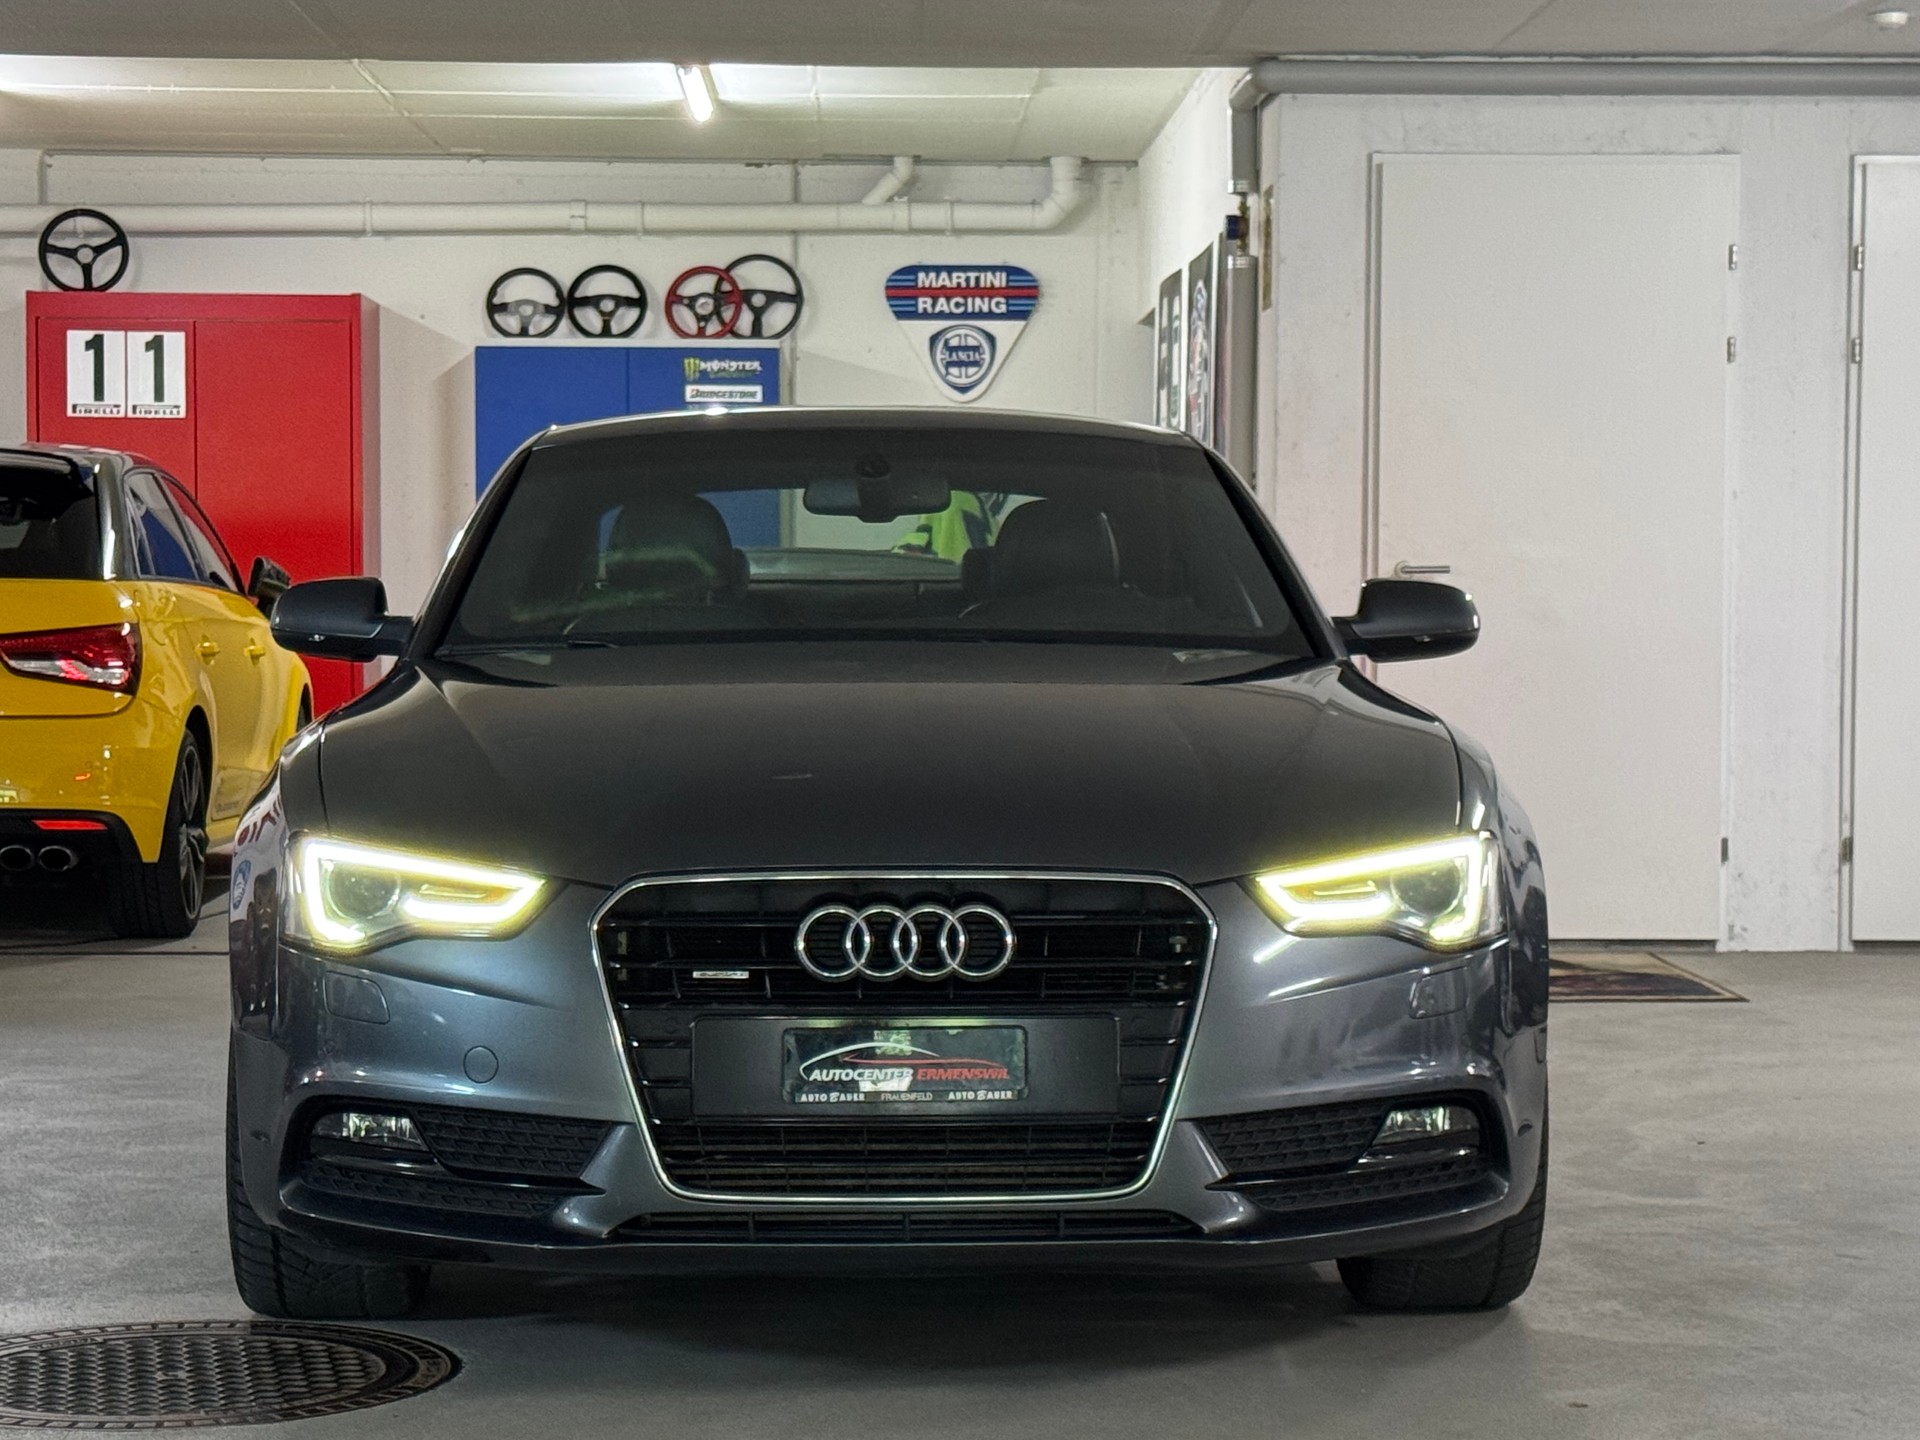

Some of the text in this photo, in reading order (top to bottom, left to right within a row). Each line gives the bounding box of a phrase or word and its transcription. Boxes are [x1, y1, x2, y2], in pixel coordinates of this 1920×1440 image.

[917, 272, 1008, 288] MARTINI
[917, 297, 1008, 314] RACING
[946, 351, 980, 362] LANCIA
[809, 1068, 914, 1082] AUTOCENTER
[800, 1093, 828, 1103] AUTO
[948, 1091, 975, 1101] AUTO
